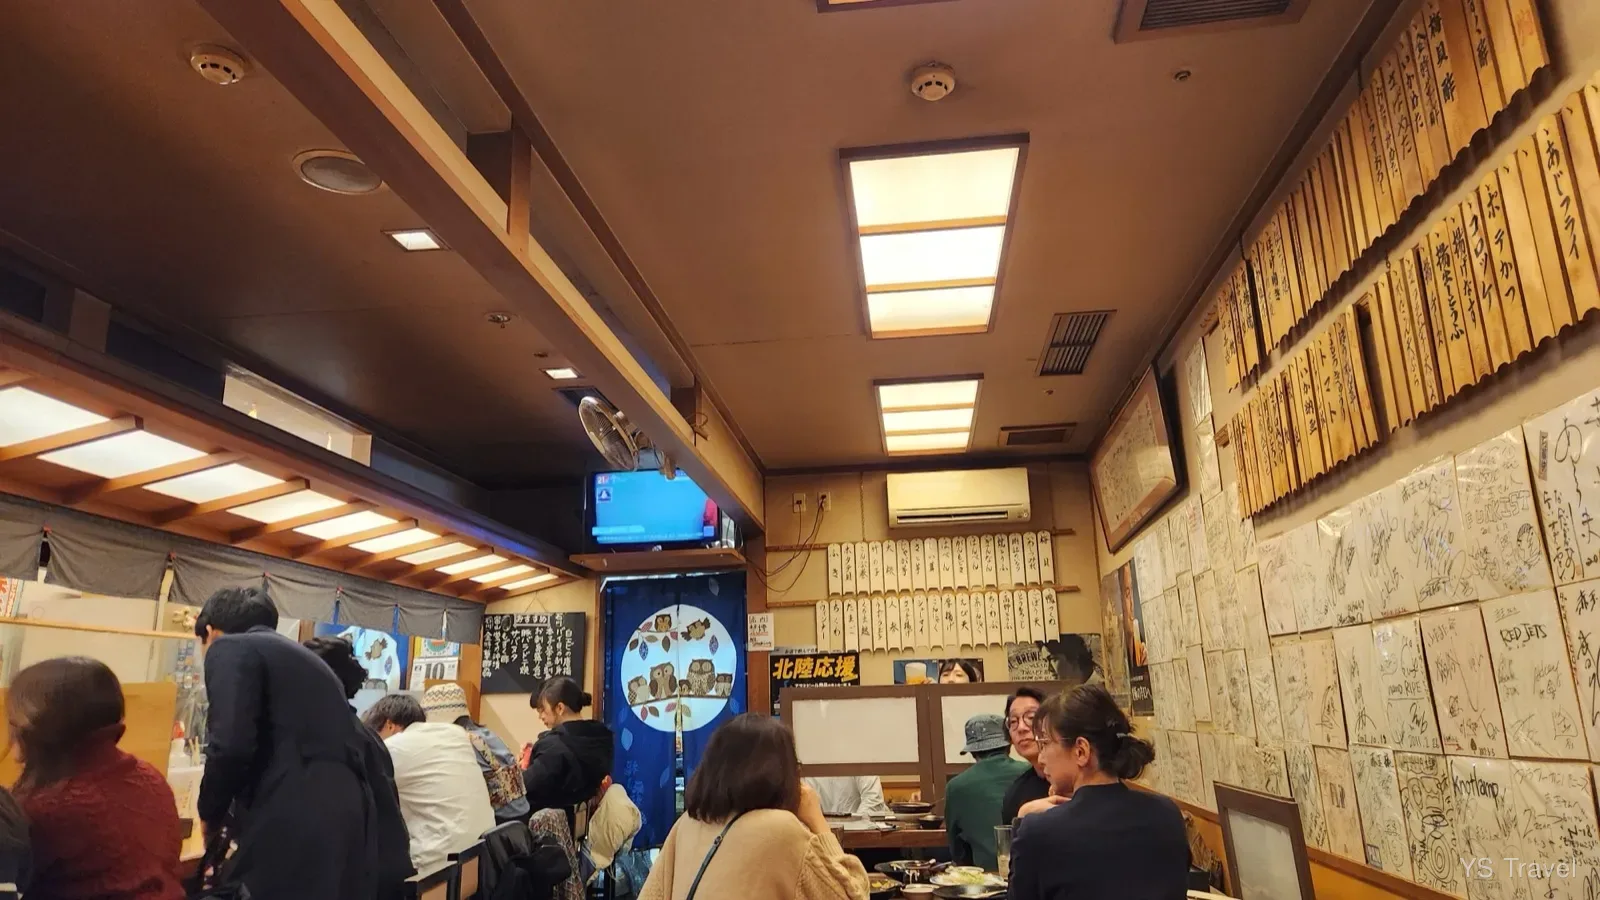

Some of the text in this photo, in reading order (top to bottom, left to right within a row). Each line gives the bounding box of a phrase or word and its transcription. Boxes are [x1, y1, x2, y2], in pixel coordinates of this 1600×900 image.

[1546, 139, 1580, 260] あじフライ
[1452, 227, 1478, 330] 揚げなす
[1468, 214, 1493, 311] コロッケ
[516, 613, 548, 624] おすすめ
[424, 662, 445, 680] 10
[773, 655, 859, 683] 北陸応援
